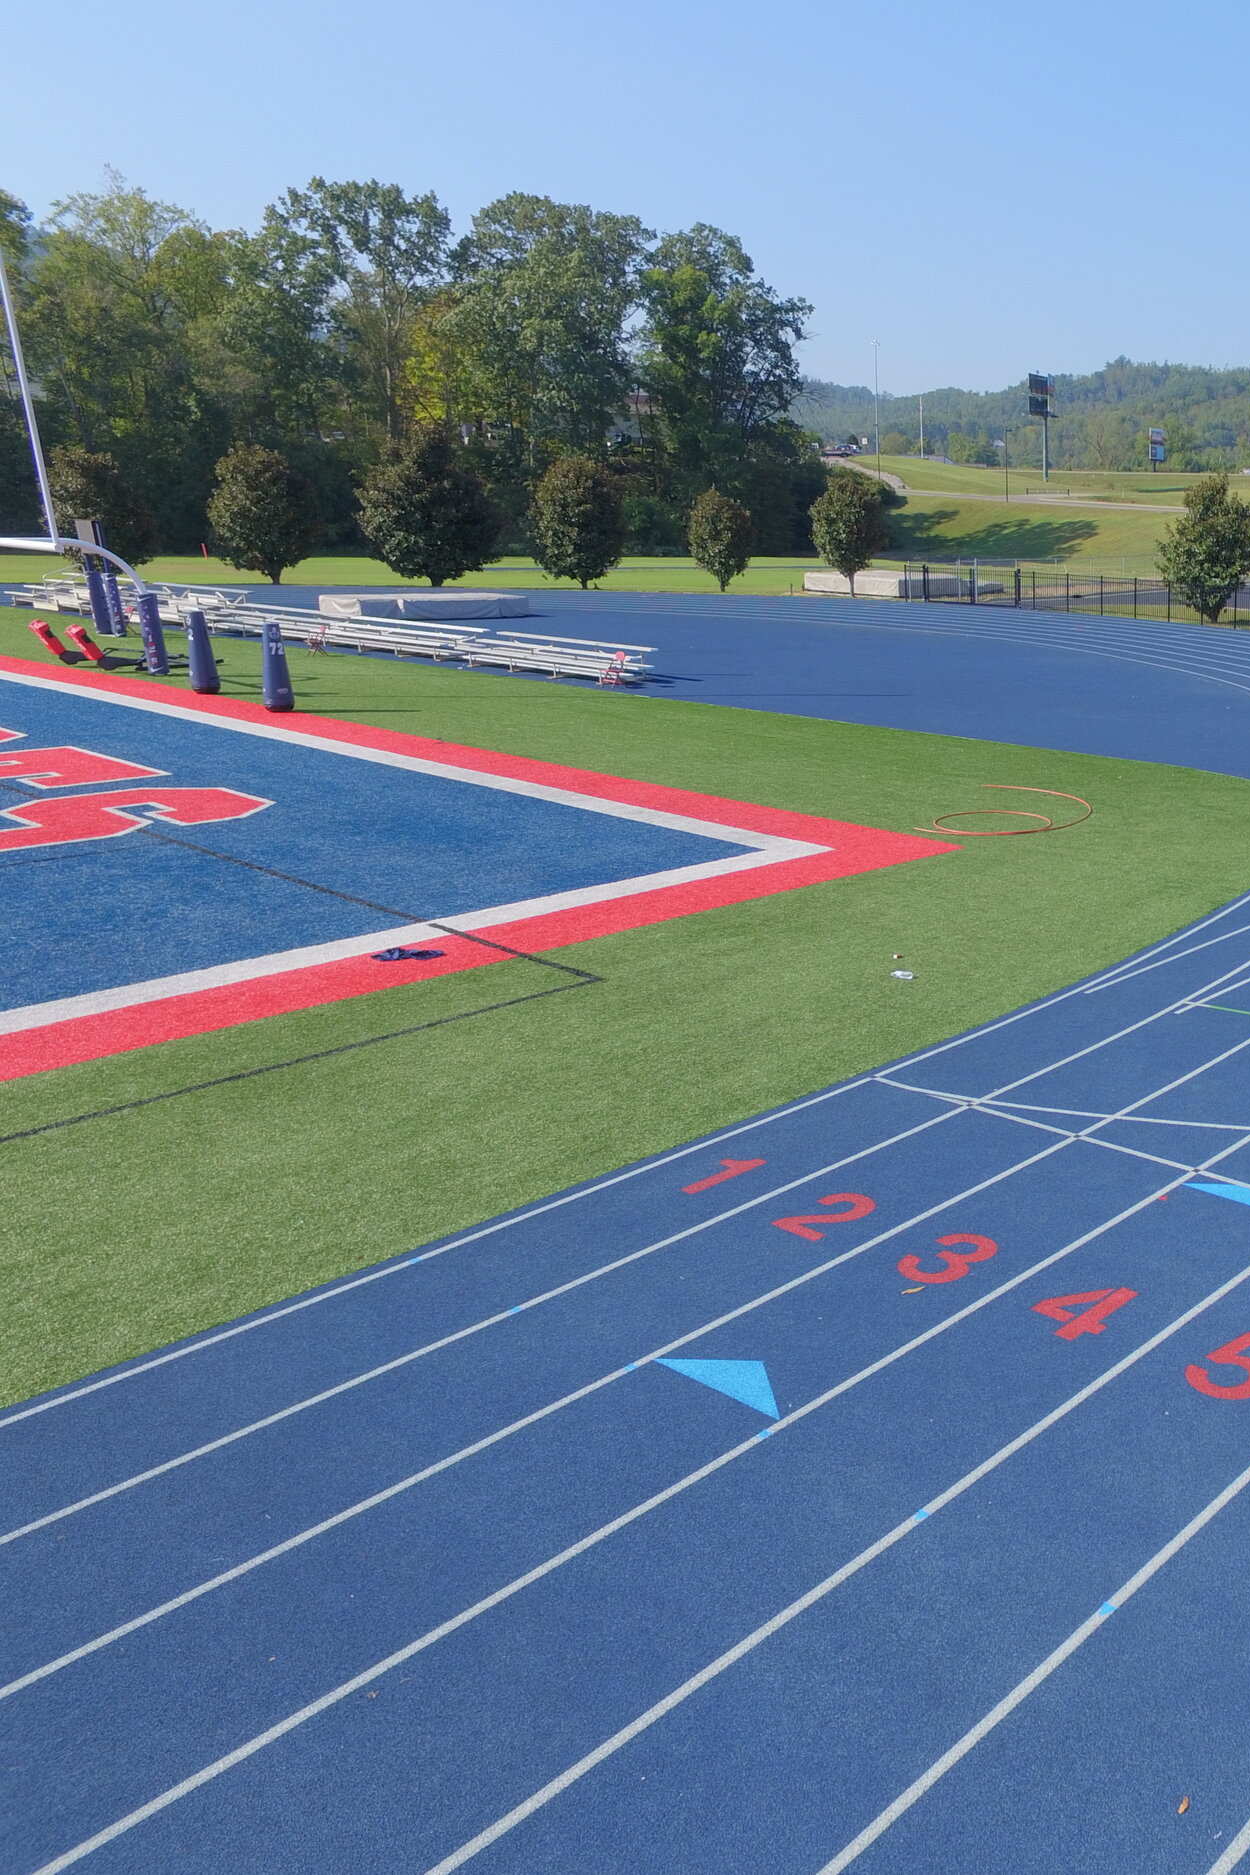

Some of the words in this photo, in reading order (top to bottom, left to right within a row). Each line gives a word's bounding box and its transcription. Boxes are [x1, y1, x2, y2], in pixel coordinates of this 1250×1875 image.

[269, 642, 284, 655] 72
[681, 1158, 767, 1195] 1
[771, 1192, 876, 1242] 2
[897, 1233, 999, 1284] 3
[1031, 1287, 1139, 1341] 4
